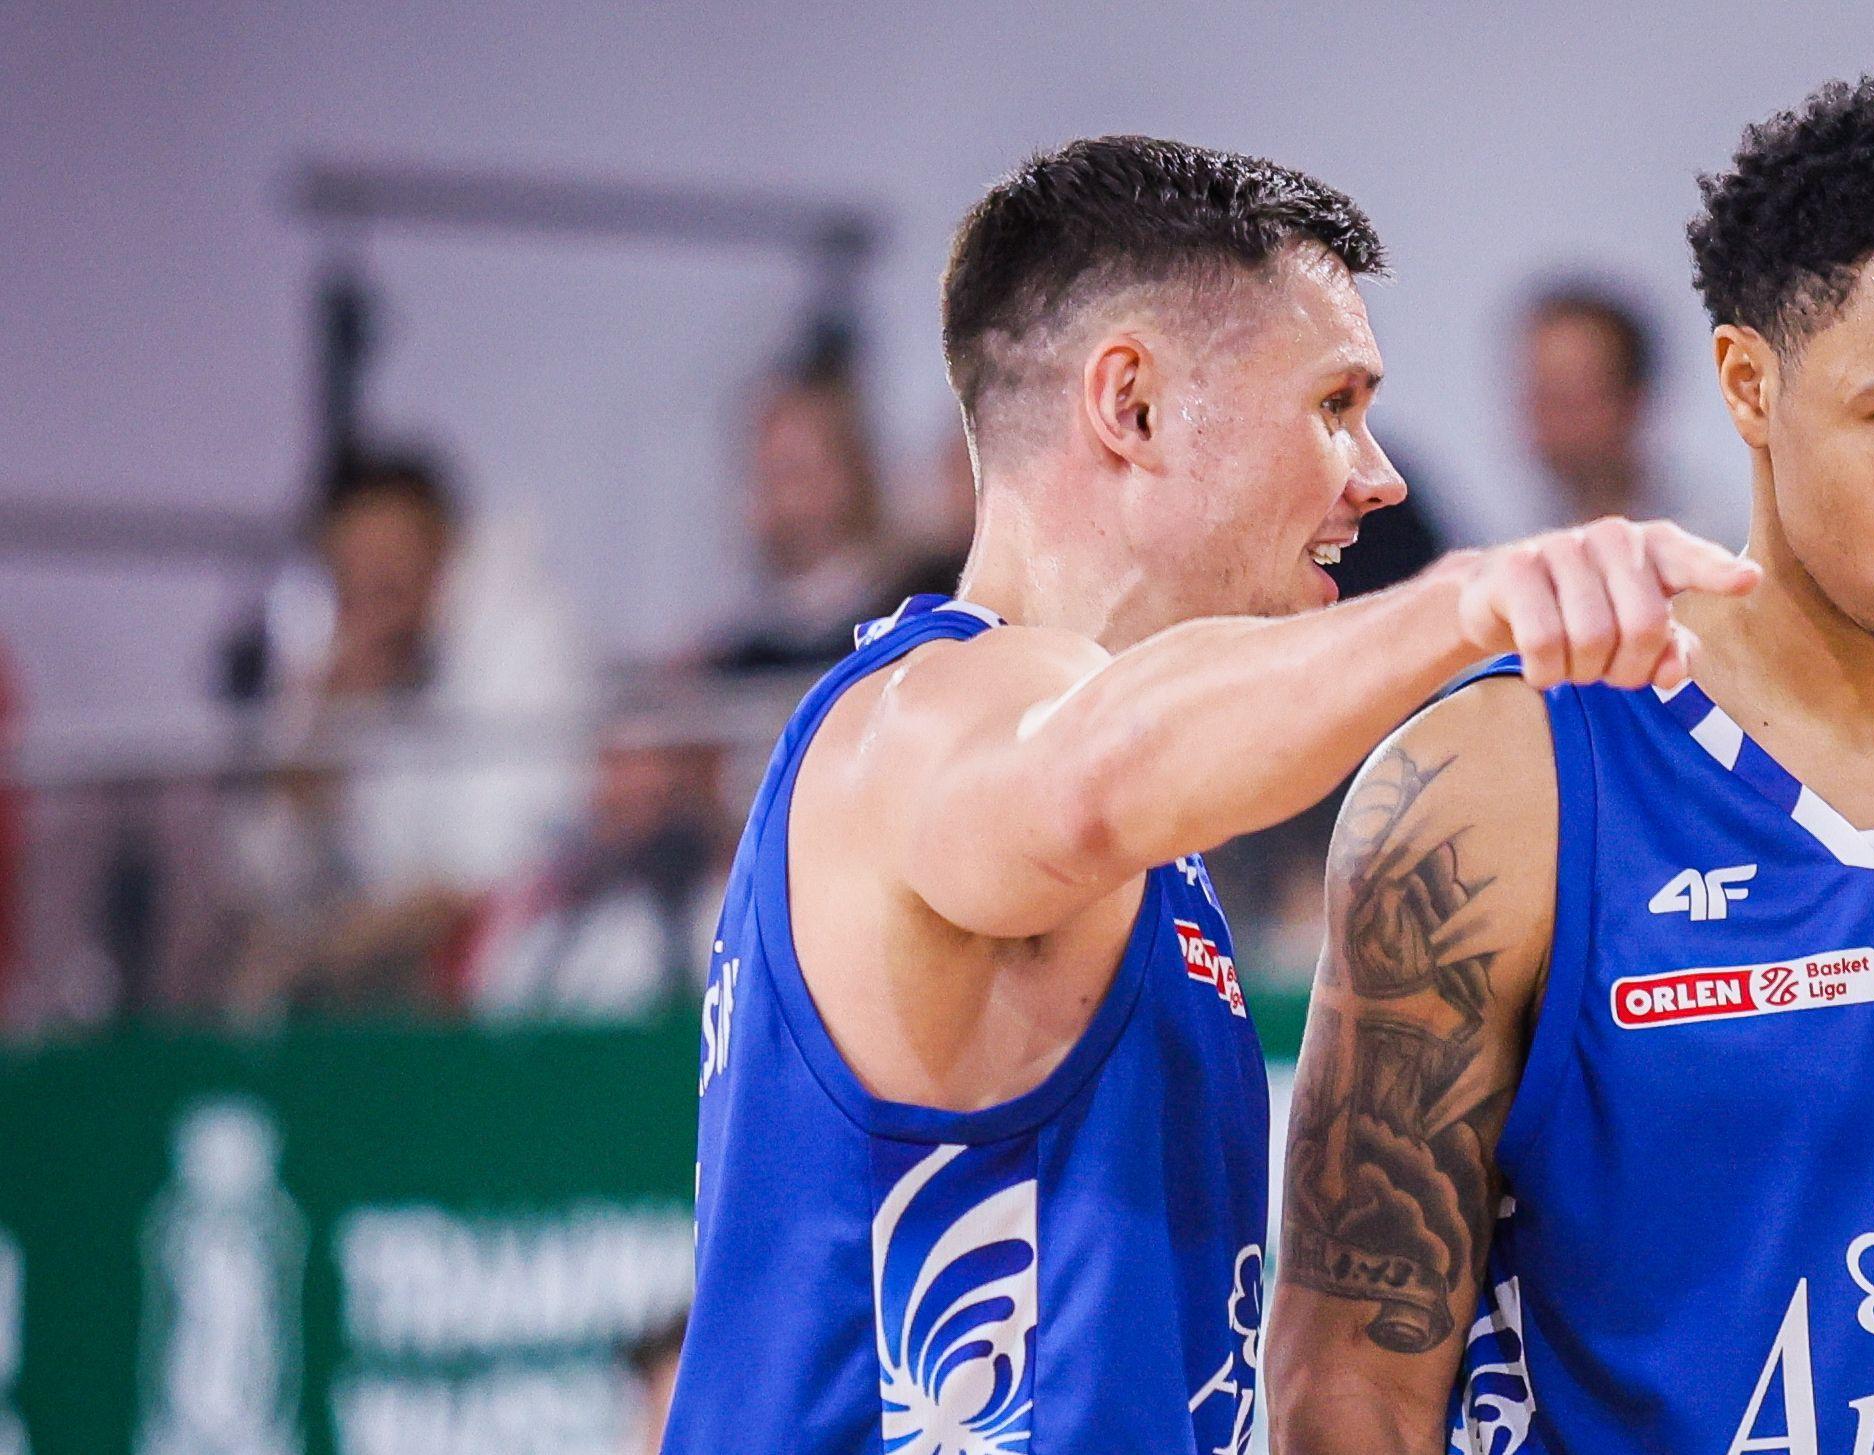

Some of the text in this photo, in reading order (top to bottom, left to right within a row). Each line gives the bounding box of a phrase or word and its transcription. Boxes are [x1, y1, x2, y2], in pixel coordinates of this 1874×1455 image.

[1648, 863, 1757, 921] 4F
[1806, 956, 1869, 978] Basket
[1625, 978, 1742, 1016] ORLEN
[1808, 980, 1847, 1001] Liga
